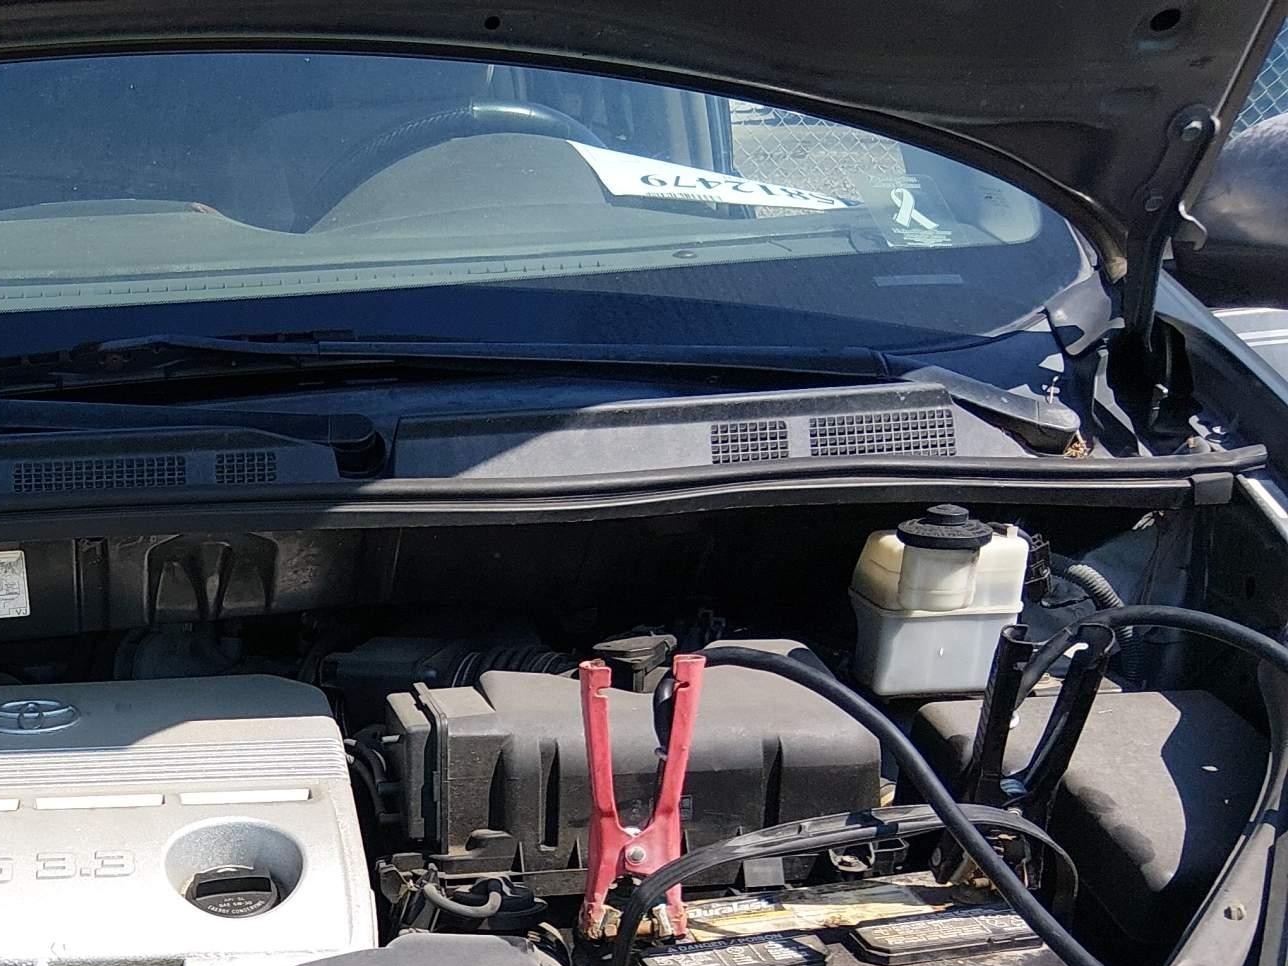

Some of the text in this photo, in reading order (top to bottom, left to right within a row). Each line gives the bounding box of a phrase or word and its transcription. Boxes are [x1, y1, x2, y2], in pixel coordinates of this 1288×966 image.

[35, 850, 136, 880] 3.3
[678, 939, 728, 952] DANGER
[739, 933, 783, 946] POISON
